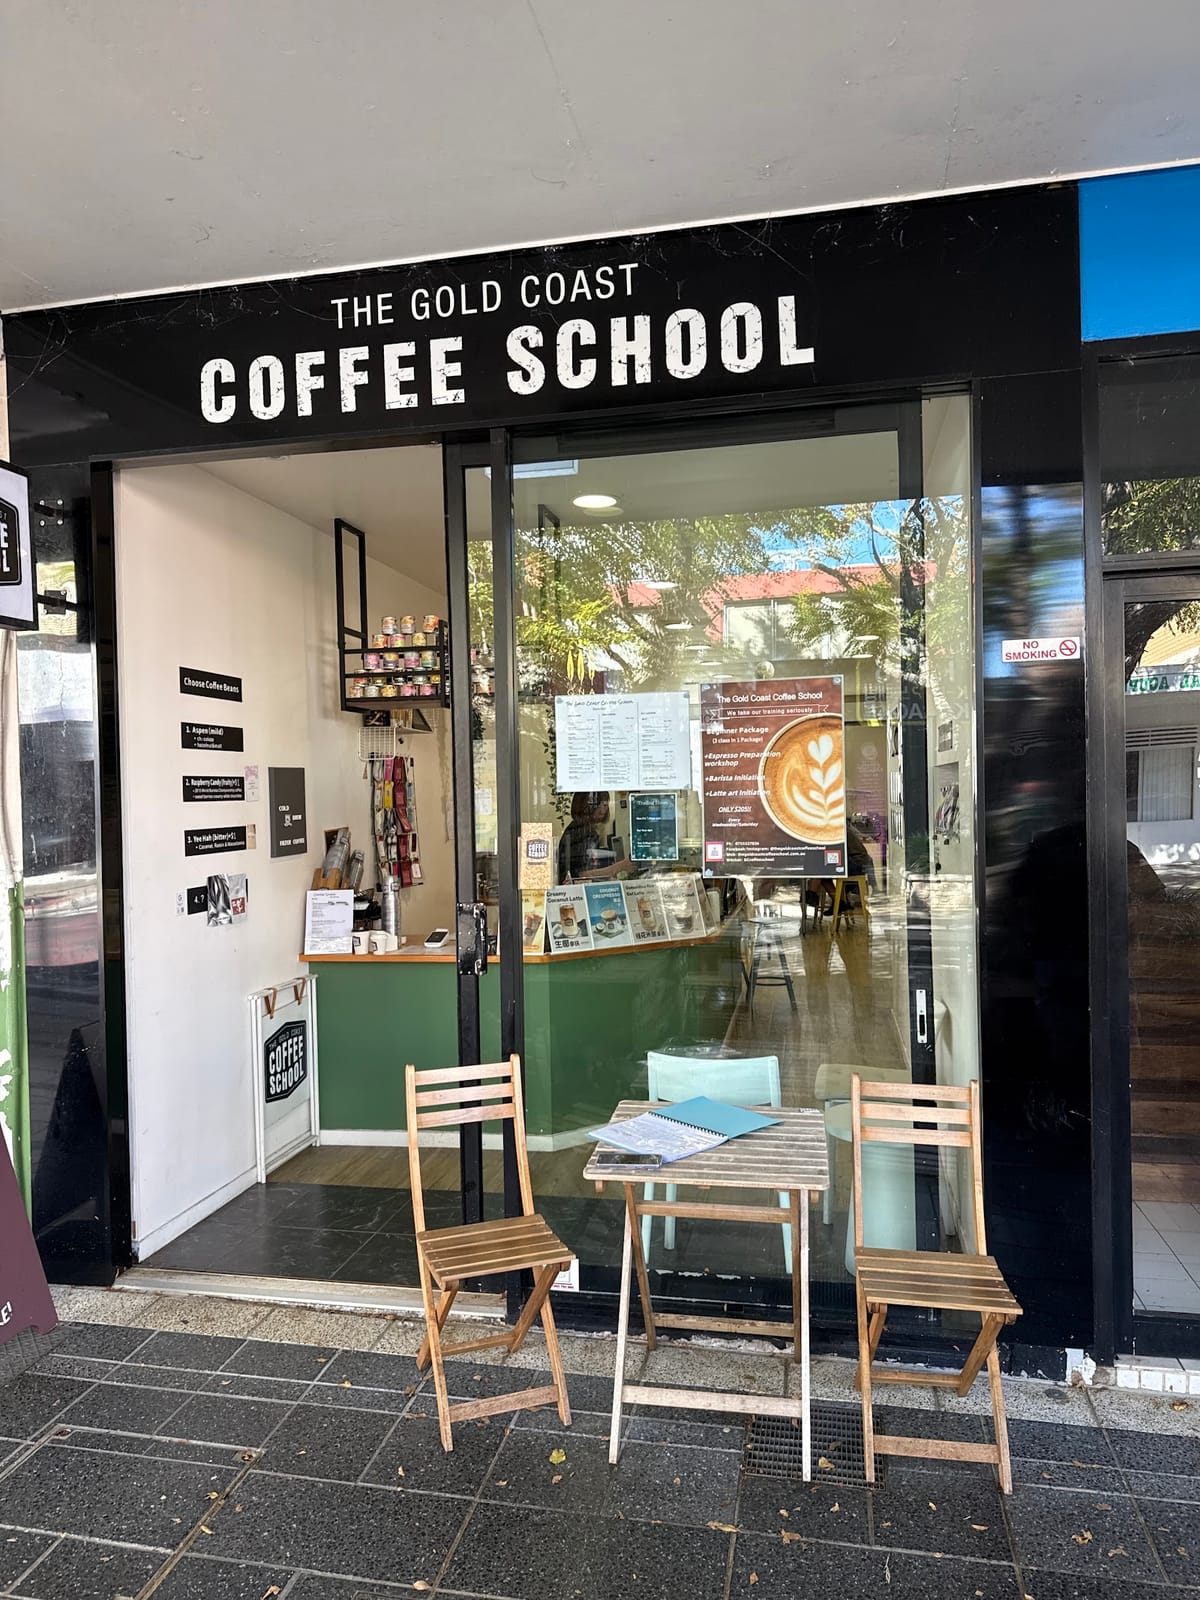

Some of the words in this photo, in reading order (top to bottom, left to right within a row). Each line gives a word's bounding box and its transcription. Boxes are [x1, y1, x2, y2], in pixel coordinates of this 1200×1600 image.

[331, 292, 394, 330] THE
[411, 280, 501, 321] GOLD
[521, 262, 638, 307] COAST
[200, 336, 466, 424] COFFEE
[506, 295, 815, 396] SCHOOL
[1023, 641, 1039, 649] NO
[1005, 649, 1057, 661] SMOKING
[183, 677, 205, 689] Choose
[205, 680, 223, 691] Coffee
[223, 683, 240, 693] Beans
[717, 694, 731, 703] The
[732, 694, 749, 703] Gold
[750, 694, 771, 702] Coast
[772, 692, 797, 701] Coffee
[798, 691, 823, 700] School
[762, 708, 785, 716] training
[786, 707, 813, 715] seriously
[192, 726, 209, 735] Aspen
[706, 727, 737, 736] Beginner
[739, 726, 769, 734] Package
[704, 752, 739, 760] +Espresso
[739, 751, 781, 760] Preparation
[705, 760, 739, 768] workshop
[279, 1031, 289, 1042] GOLD
[291, 1026, 303, 1037] COAST
[269, 1035, 304, 1075] COFFEE
[269, 1058, 304, 1095] SCHOOL
